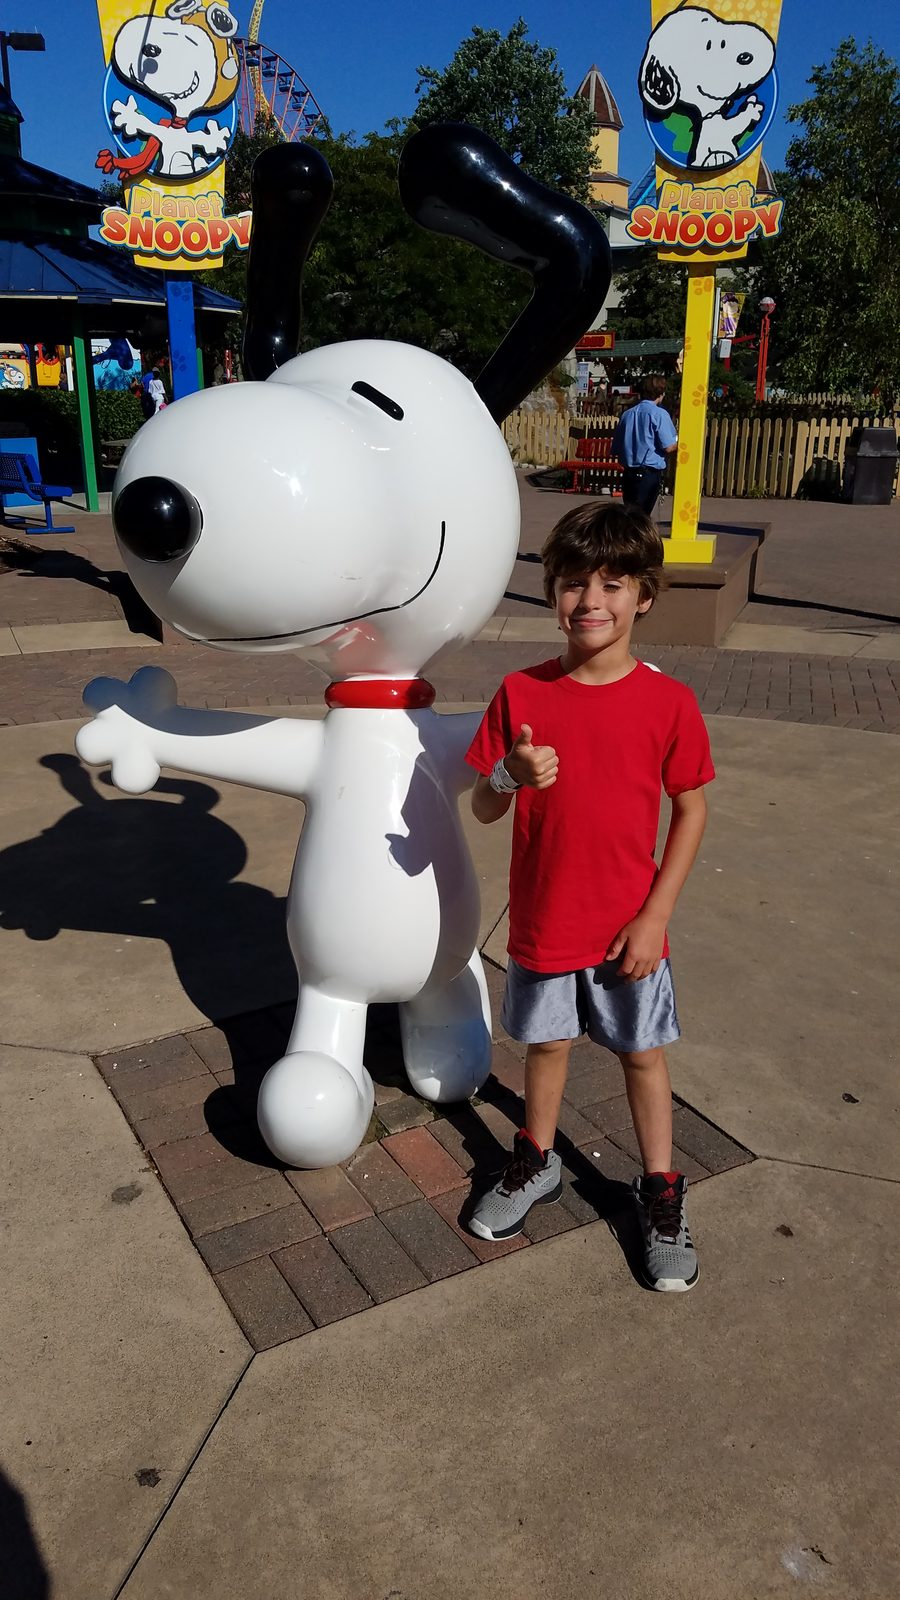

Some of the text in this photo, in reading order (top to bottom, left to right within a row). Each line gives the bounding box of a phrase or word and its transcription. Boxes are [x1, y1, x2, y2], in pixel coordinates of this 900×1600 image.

[132, 188, 222, 218] Planet
[660, 183, 751, 211] Planet
[102, 211, 250, 251] SNOOPY
[629, 203, 780, 244] SNOOPY
